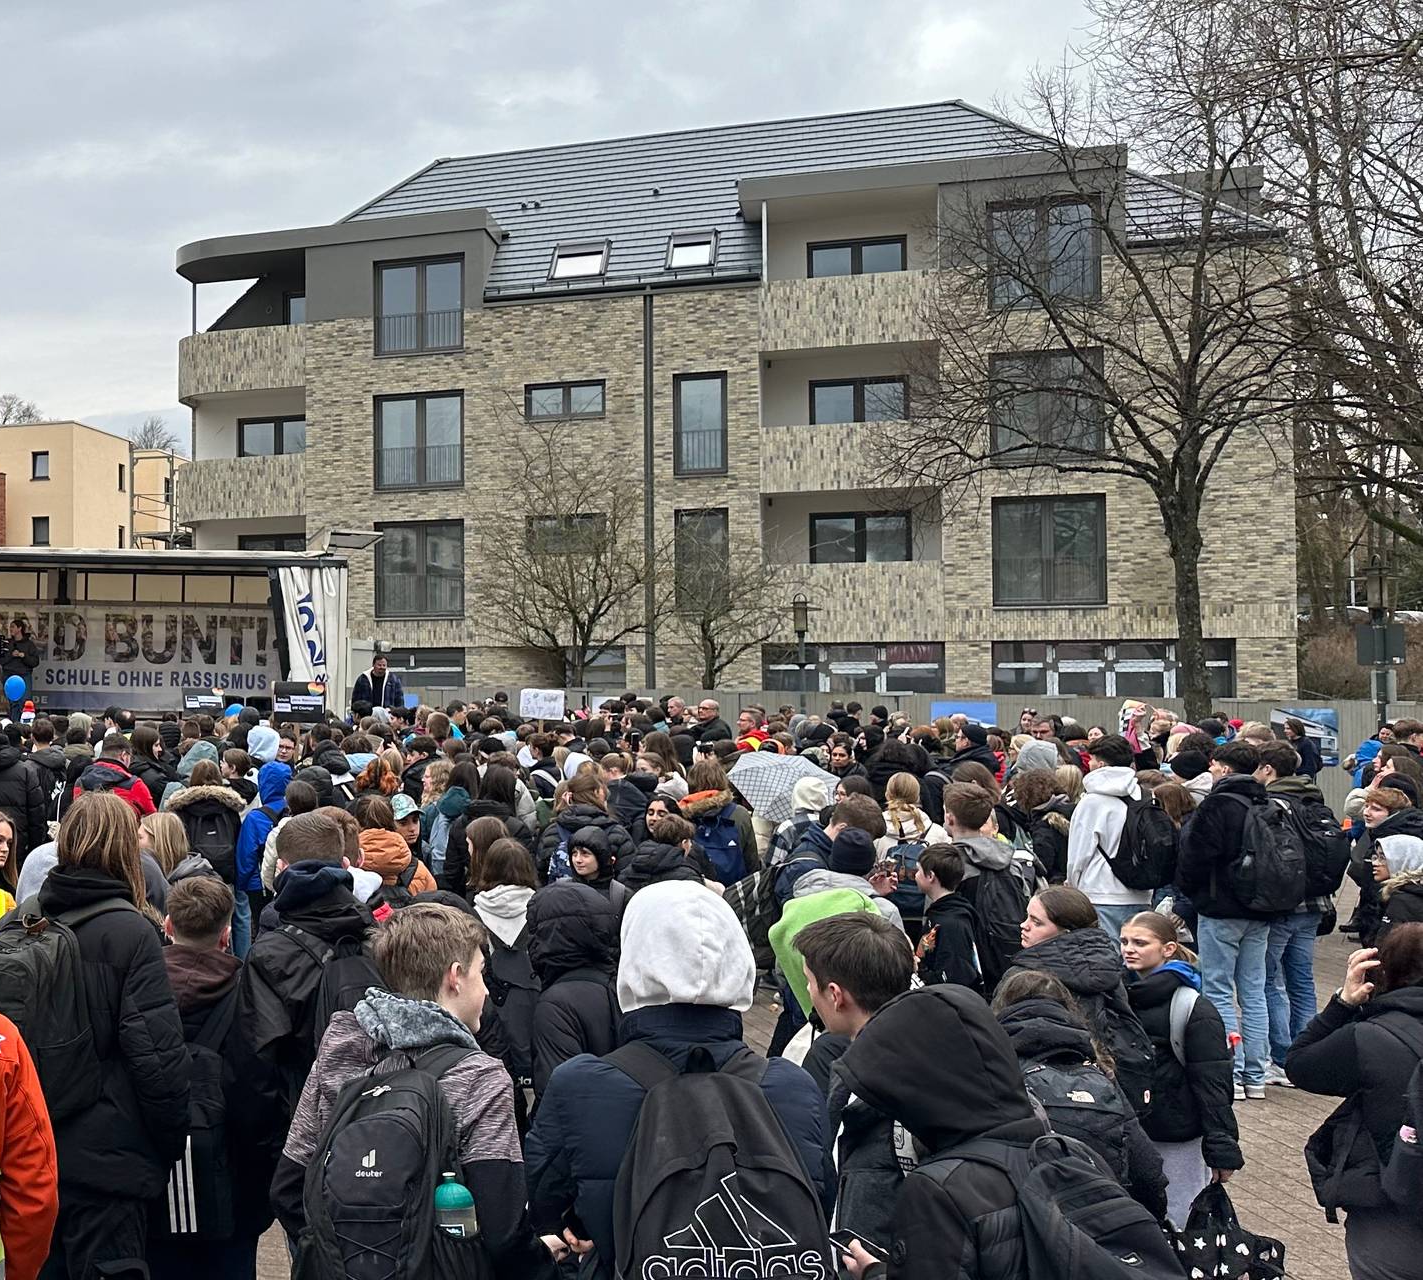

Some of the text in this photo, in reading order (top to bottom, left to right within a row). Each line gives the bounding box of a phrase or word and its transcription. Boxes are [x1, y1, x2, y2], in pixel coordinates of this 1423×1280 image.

[105, 613, 268, 667] BUNT!
[45, 668, 267, 690] SCHULE OHNE RASSISMUS
[355, 1170, 383, 1178] deuter
[642, 1248, 825, 1280] adidas
